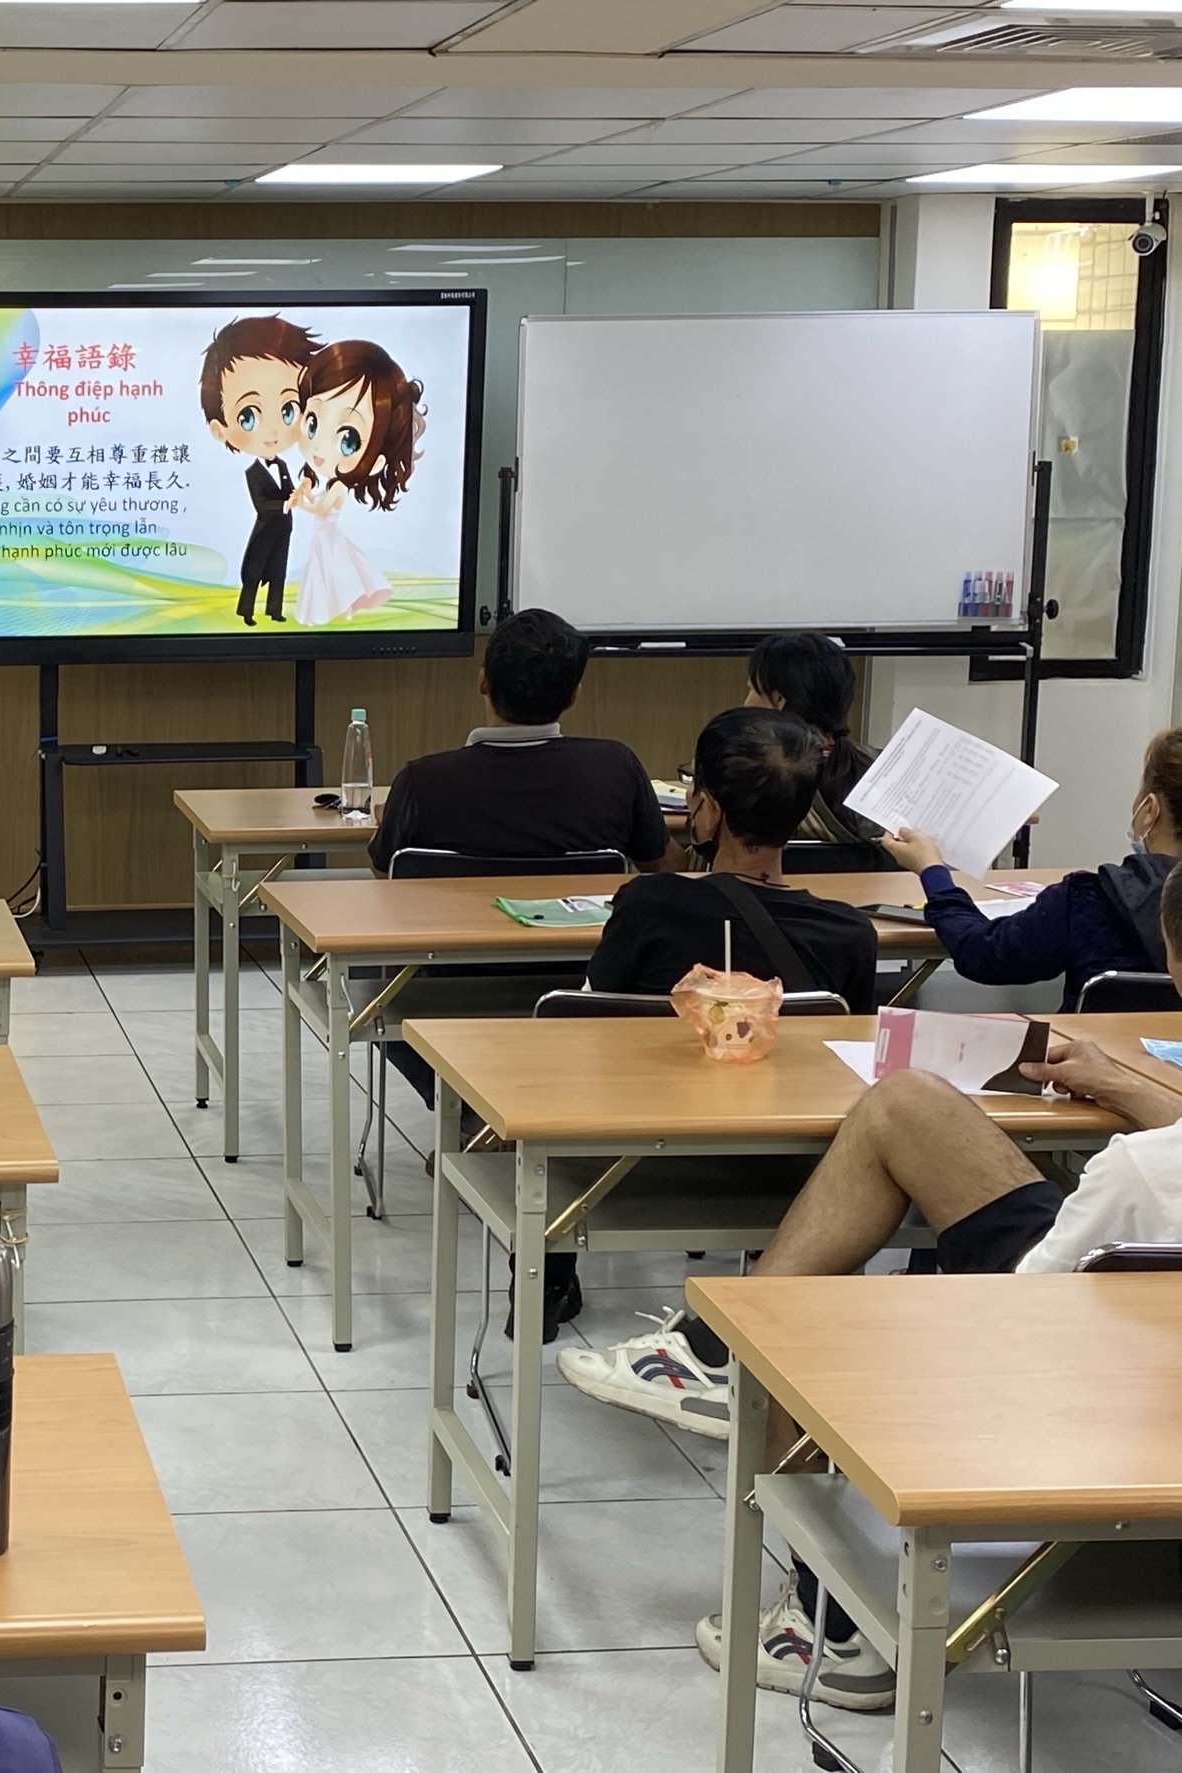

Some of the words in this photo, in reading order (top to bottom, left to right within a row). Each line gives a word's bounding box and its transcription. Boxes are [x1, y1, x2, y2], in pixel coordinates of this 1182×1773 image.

[13, 341, 136, 372] 幸福語錄
[13, 380, 69, 400] Thông
[74, 380, 114, 400] điệp
[119, 380, 163, 400] hạnh
[68, 406, 110, 426] phúc
[14, 496, 40, 513] cần
[45, 498, 63, 513] có
[67, 500, 86, 514] sự
[90, 496, 117, 515] yêu
[122, 497, 179, 514] thương
[37, 521, 54, 535] và
[59, 520, 84, 535] tôn
[89, 522, 130, 538] trọng
[135, 517, 157, 534] lẫn
[2, 544, 39, 560] hạnh
[45, 543, 82, 561] phúc
[87, 543, 116, 557] mới
[121, 543, 161, 559] được
[165, 542, 187, 557] lâu
